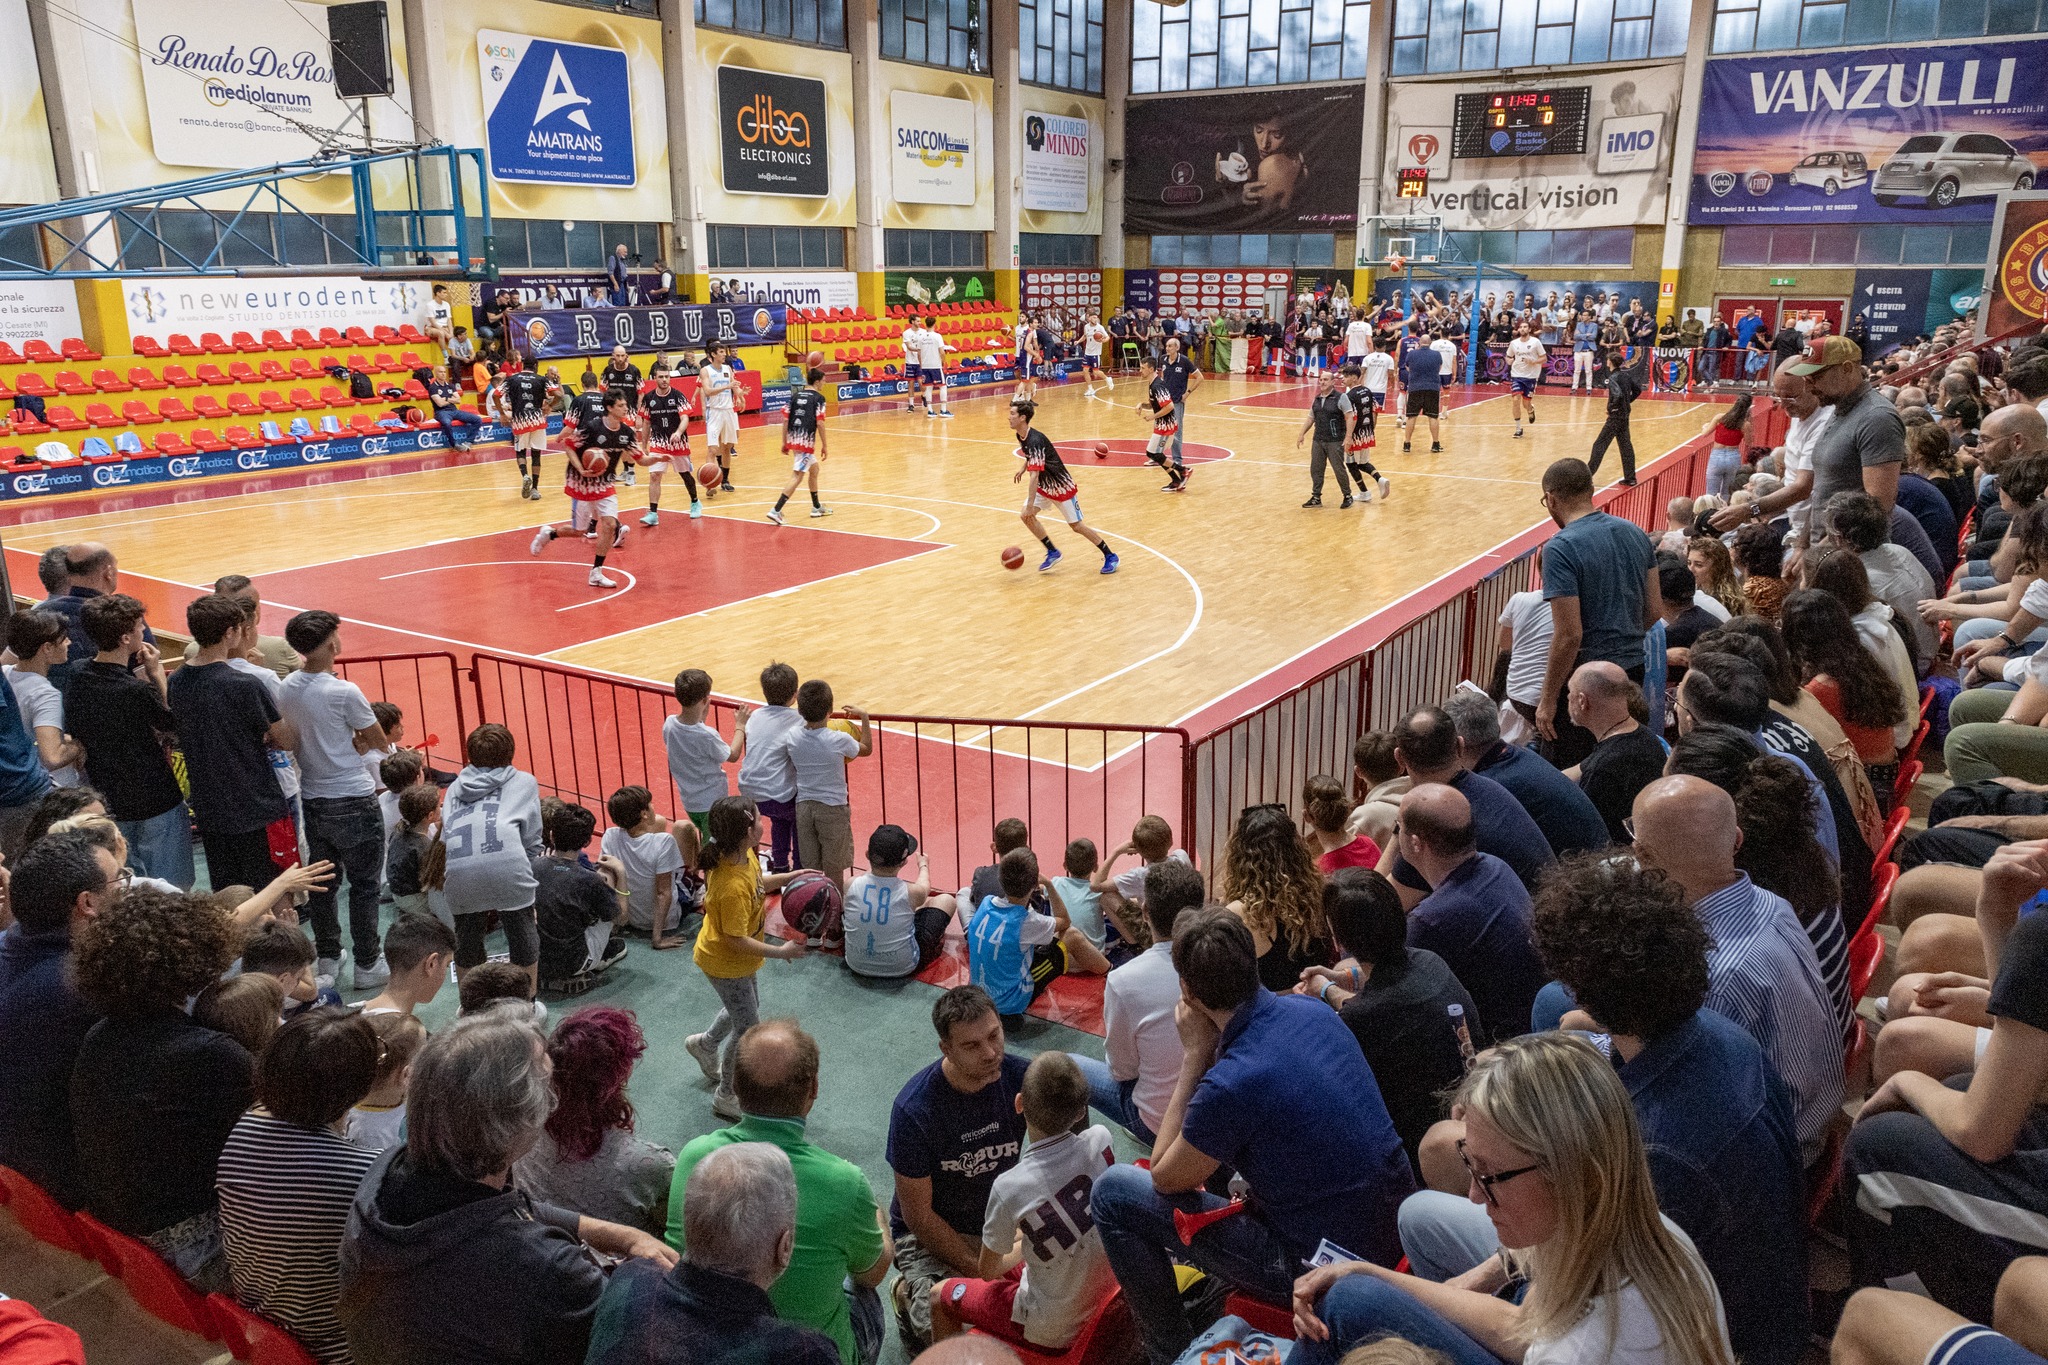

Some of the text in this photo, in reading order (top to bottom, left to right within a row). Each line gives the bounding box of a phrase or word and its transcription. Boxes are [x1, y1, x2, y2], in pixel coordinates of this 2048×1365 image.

[152, 35, 335, 84] Renato DeRos
[494, 46, 515, 59] SCN
[1750, 58, 2017, 114] VANZULLI
[208, 84, 312, 106] mediolanum
[1495, 94, 1550, 107] 0 11:43 0
[286, 106, 312, 114] BANKING
[1973, 105, 2044, 115] www.vanzulli.it
[737, 94, 811, 148] diba
[1496, 111, 1553, 126] 0 0
[1046, 118, 1087, 137] COLORED
[527, 130, 603, 152] AMATRANS
[898, 127, 947, 150] SARCOM
[1046, 133, 1087, 157] MINDS
[527, 149, 541, 158] Your
[542, 150, 568, 161] shipment
[588, 154, 603, 163] place
[740, 148, 811, 165] ELECTRONICS
[1403, 169, 1426, 178] 11:43
[1401, 181, 1423, 198] 24
[1752, 177, 1769, 190] FIAT
[1430, 184, 1618, 211] vertical vision
[1876, 287, 1903, 295] USCITA
[10, 305, 19, 313] la
[22, 305, 65, 313] sicurezza
[1874, 303, 1906, 311] SERVIZIO
[228, 312, 273, 322] STUDIO
[279, 310, 347, 321] DENTISTICO
[1872, 311, 1888, 319] BAR
[1871, 325, 1898, 333] SERVIZI
[1870, 333, 1882, 341] WC
[242, 451, 297, 466] pneumatica
[307, 444, 358, 459] pneumatica
[174, 457, 233, 473] pneumatica
[99, 465, 163, 482] pneumatica
[19, 474, 82, 491] pneumatica
[860, 884, 891, 926] 58
[975, 914, 1007, 961] 44
